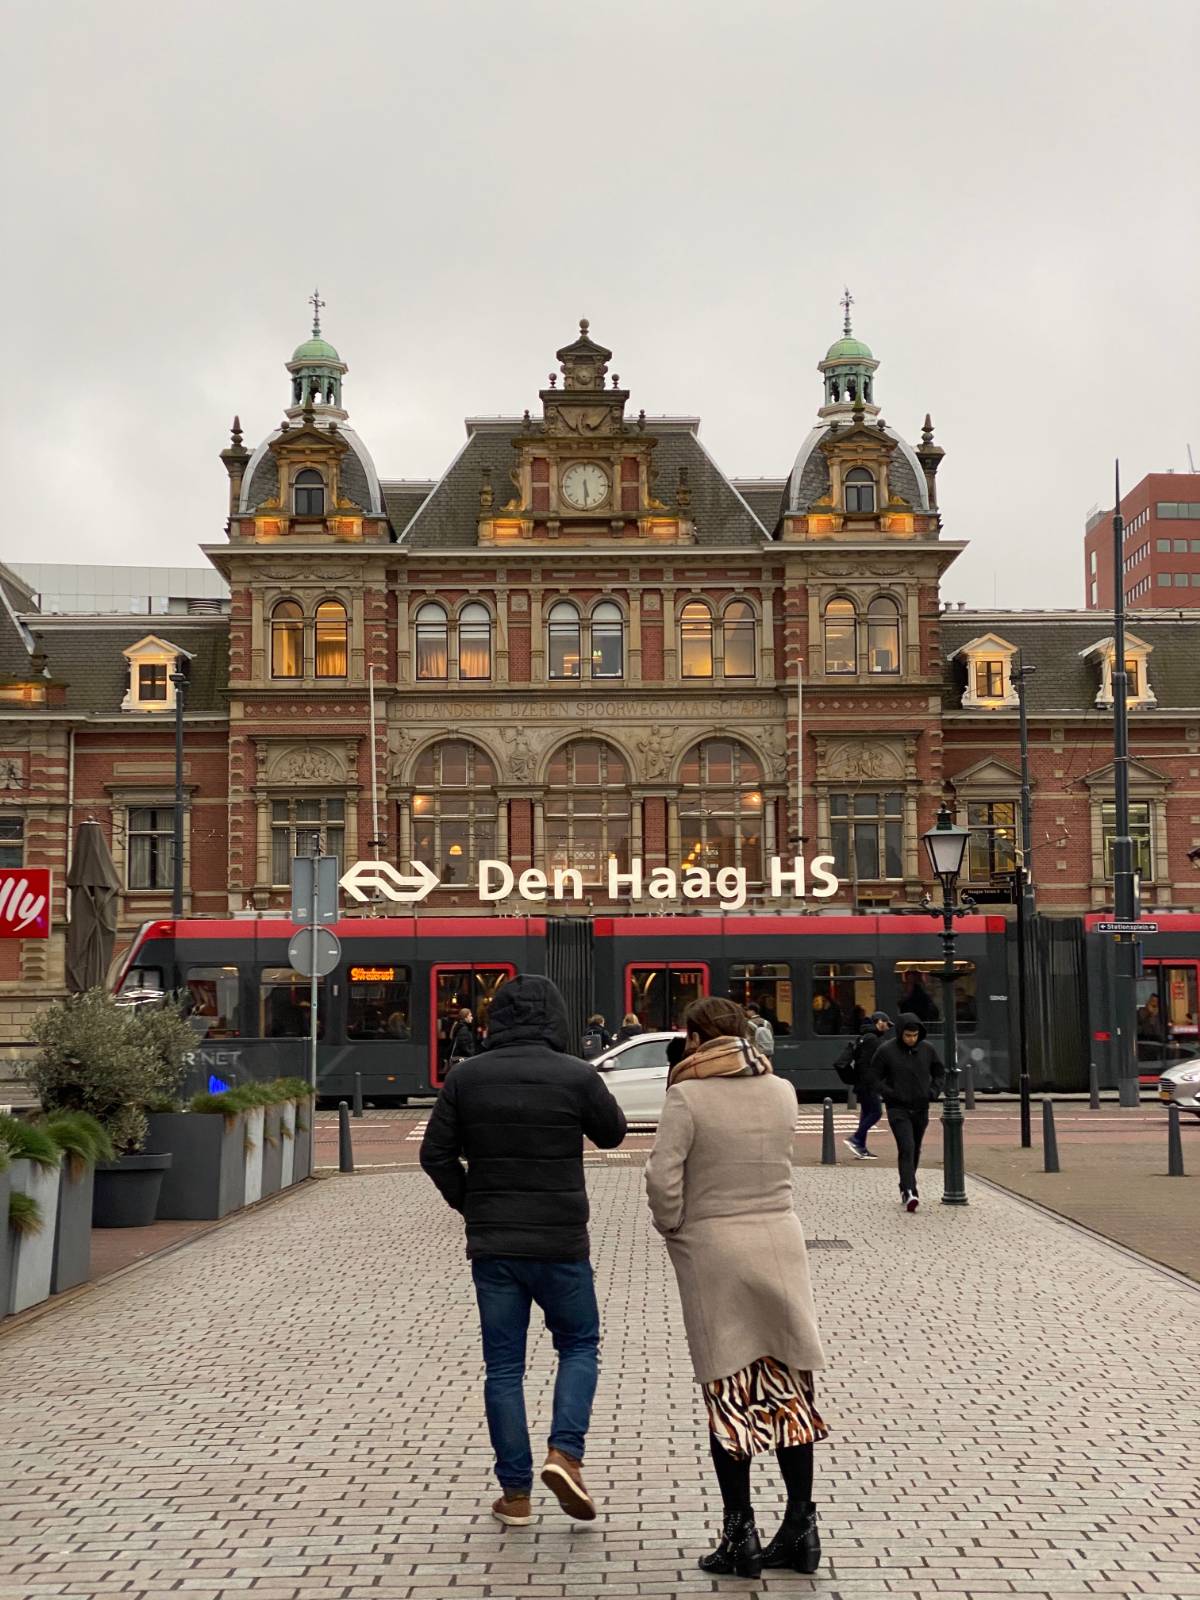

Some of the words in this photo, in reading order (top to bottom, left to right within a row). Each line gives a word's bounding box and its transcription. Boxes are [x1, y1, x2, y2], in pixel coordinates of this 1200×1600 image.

[394, 703, 504, 718] HOLLANDSCHE
[478, 859, 583, 900] Den
[608, 858, 747, 910] Haag
[771, 855, 839, 897] HS
[0, 877, 46, 932] lly
[1106, 923, 1149, 931] Stationsplein
